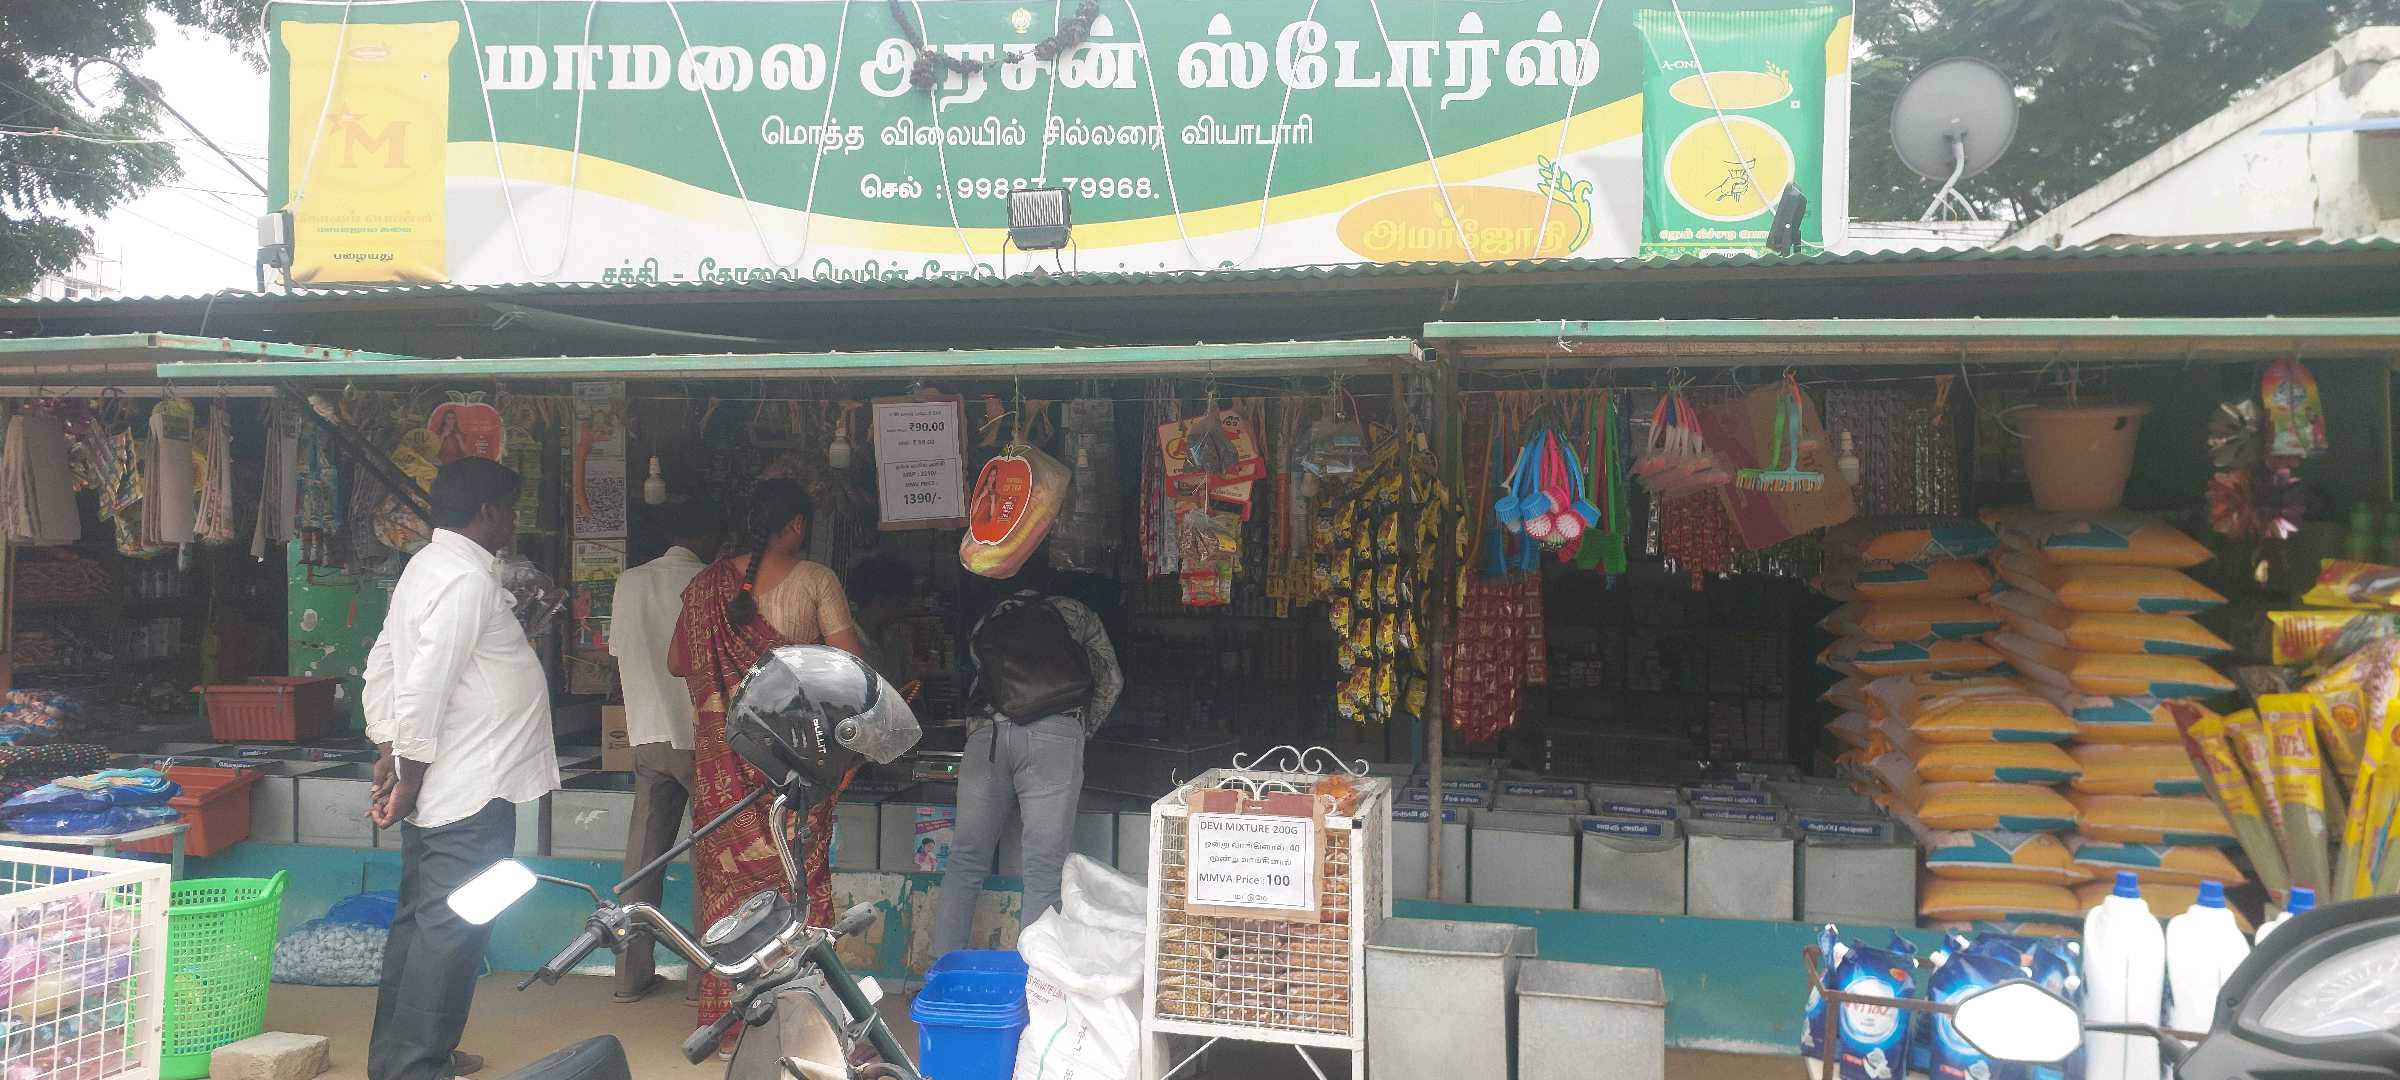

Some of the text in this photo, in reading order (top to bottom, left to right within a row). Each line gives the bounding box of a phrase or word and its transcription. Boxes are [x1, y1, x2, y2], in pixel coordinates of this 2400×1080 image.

[484, 10, 1600, 112] மாமலை அரசன் ஸ்டோர்ஸ்
[761, 113, 1314, 156] மொத்த விலையில் சில்லரை வியாபாரி
[860, 173, 923, 199] செல்
[1200, 821, 1298, 835] DEVI MIXTURE 200G
[1199, 873, 1233, 883] MMVA
